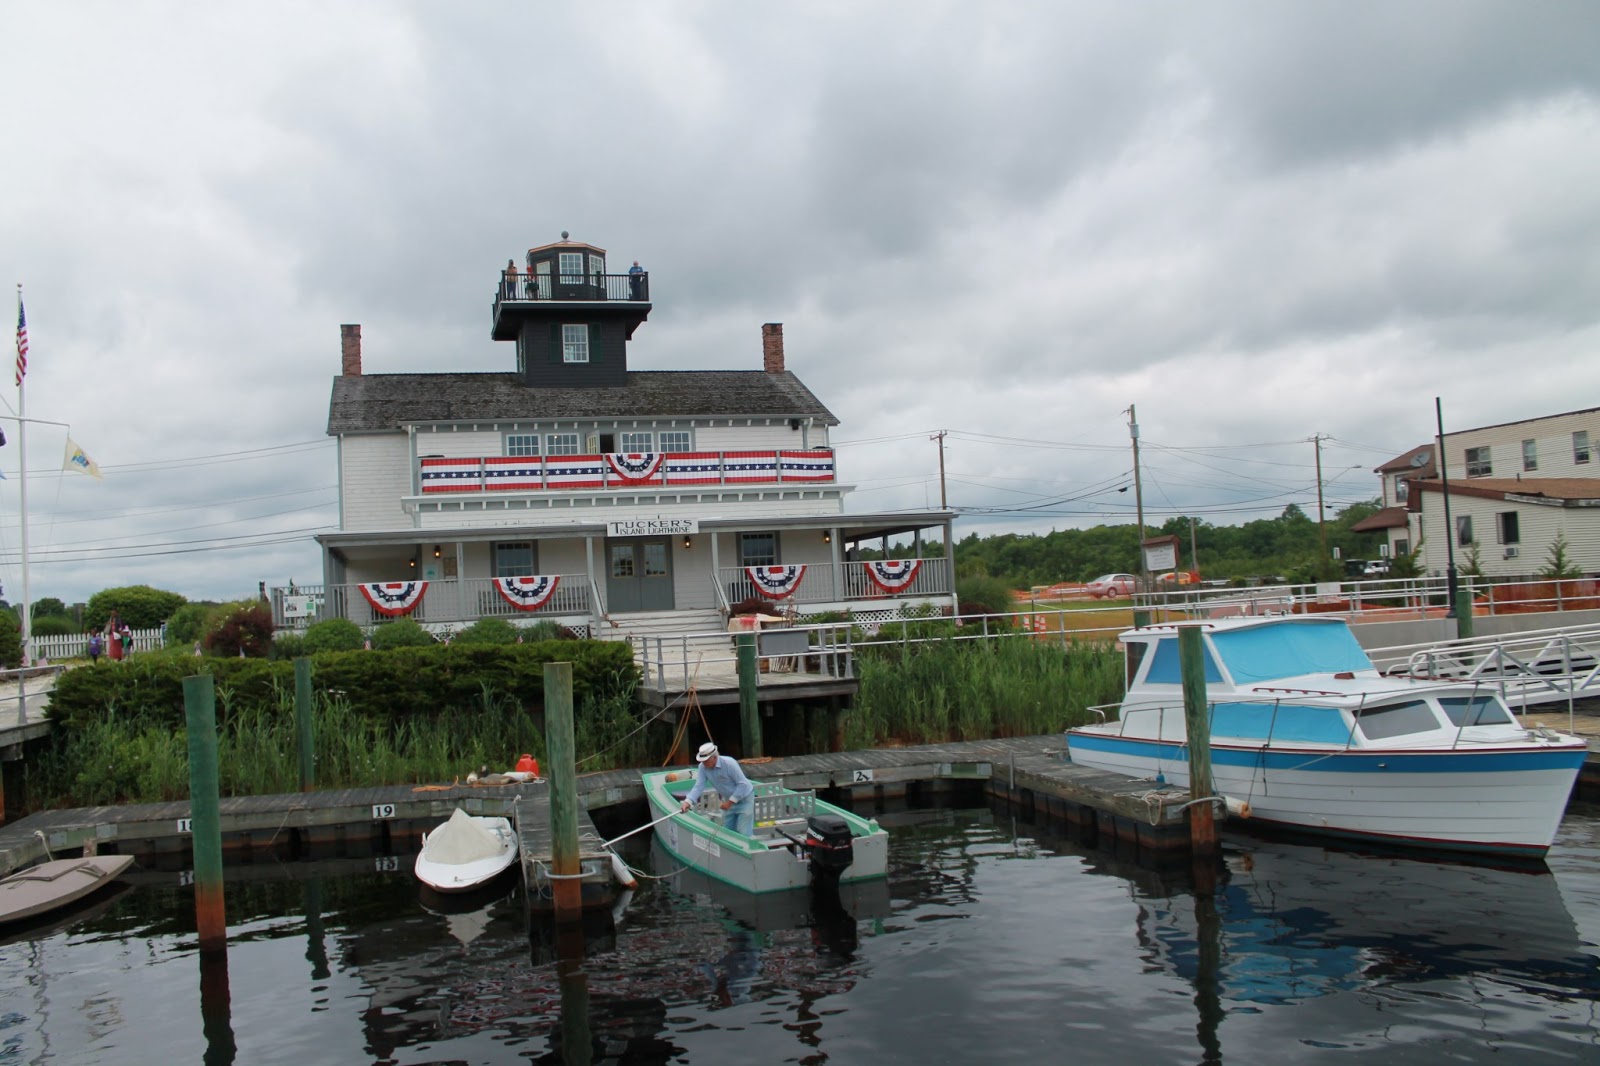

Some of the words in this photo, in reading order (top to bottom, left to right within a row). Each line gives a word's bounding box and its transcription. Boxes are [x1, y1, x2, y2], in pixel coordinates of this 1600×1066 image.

[610, 520, 692, 534] TUCKER'S
[648, 527, 690, 535] LIGHTHOUSE
[375, 805, 393, 817] 19
